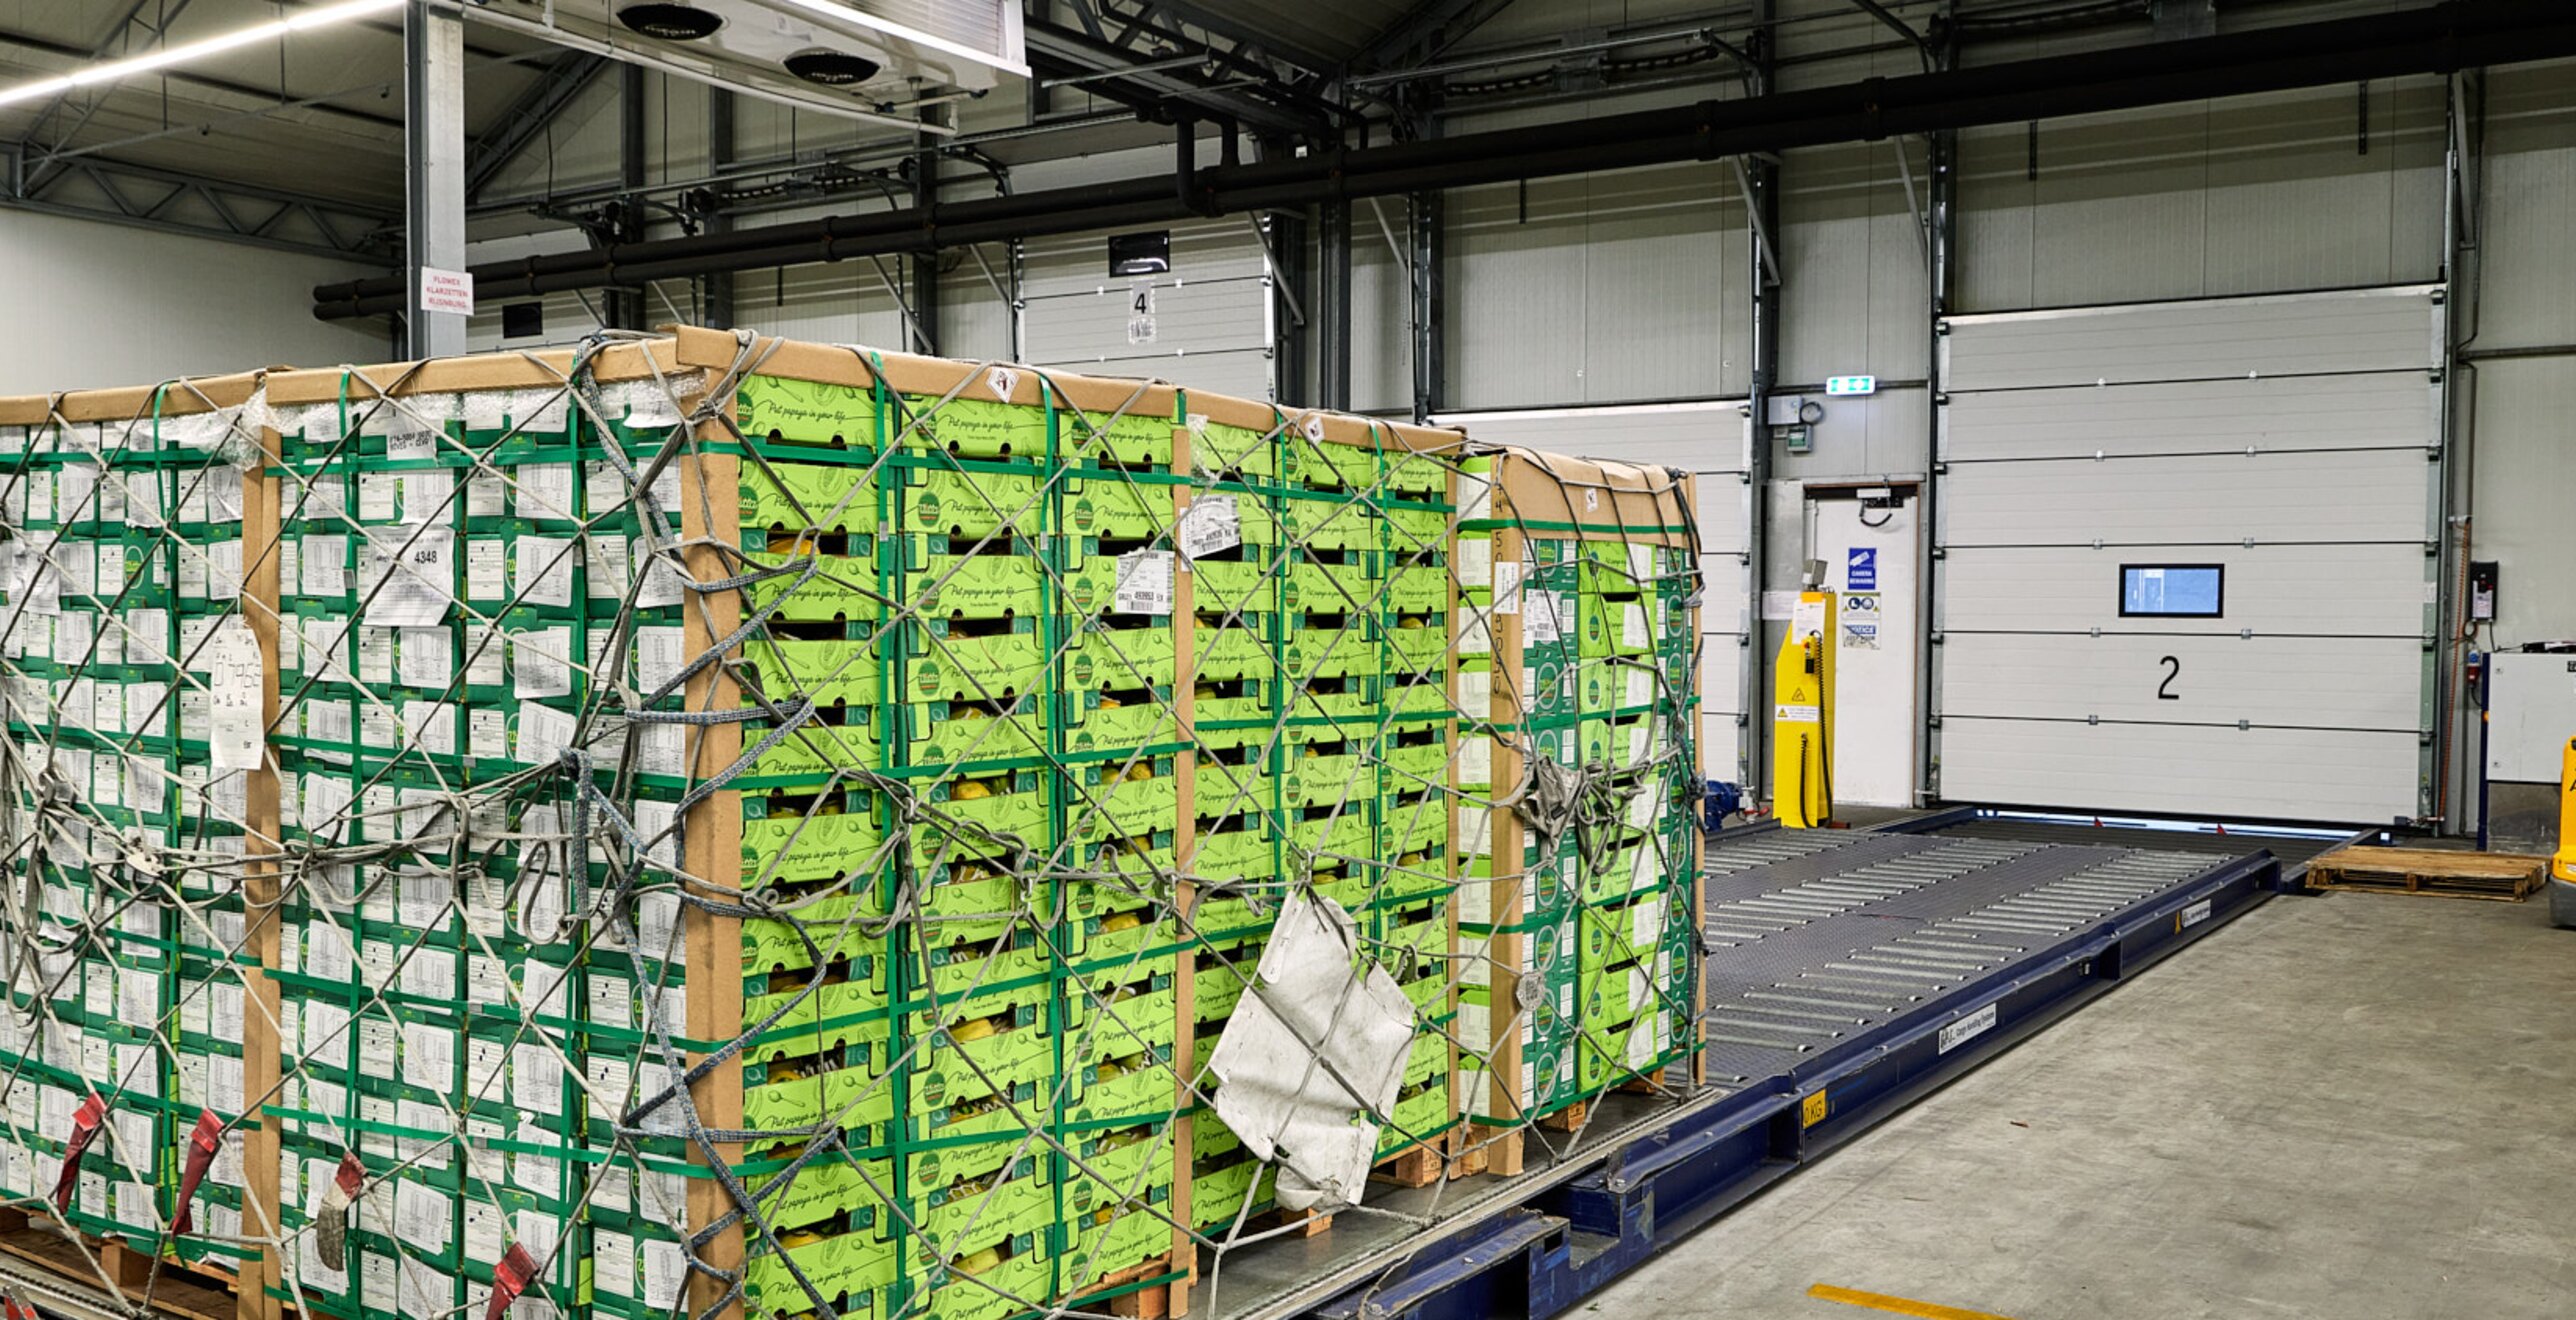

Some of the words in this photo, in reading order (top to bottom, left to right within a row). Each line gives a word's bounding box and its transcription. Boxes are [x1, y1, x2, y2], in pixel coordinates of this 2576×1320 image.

[1134, 292, 1147, 314] 4
[768, 405, 782, 414] Put
[781, 408, 806, 419] papaya
[816, 413, 832, 422] your
[834, 410, 845, 424] life
[948, 417, 959, 426] Put
[959, 421, 979, 431] papaya
[987, 423, 1001, 432] your
[951, 501, 962, 510] Put
[414, 550, 437, 564] 4348
[951, 585, 962, 594] Put
[962, 589, 982, 598] papaya
[990, 590, 1003, 598] your
[2158, 655, 2181, 700] 2
[774, 763, 787, 771] Put
[1811, 1100, 1822, 1120] KG
